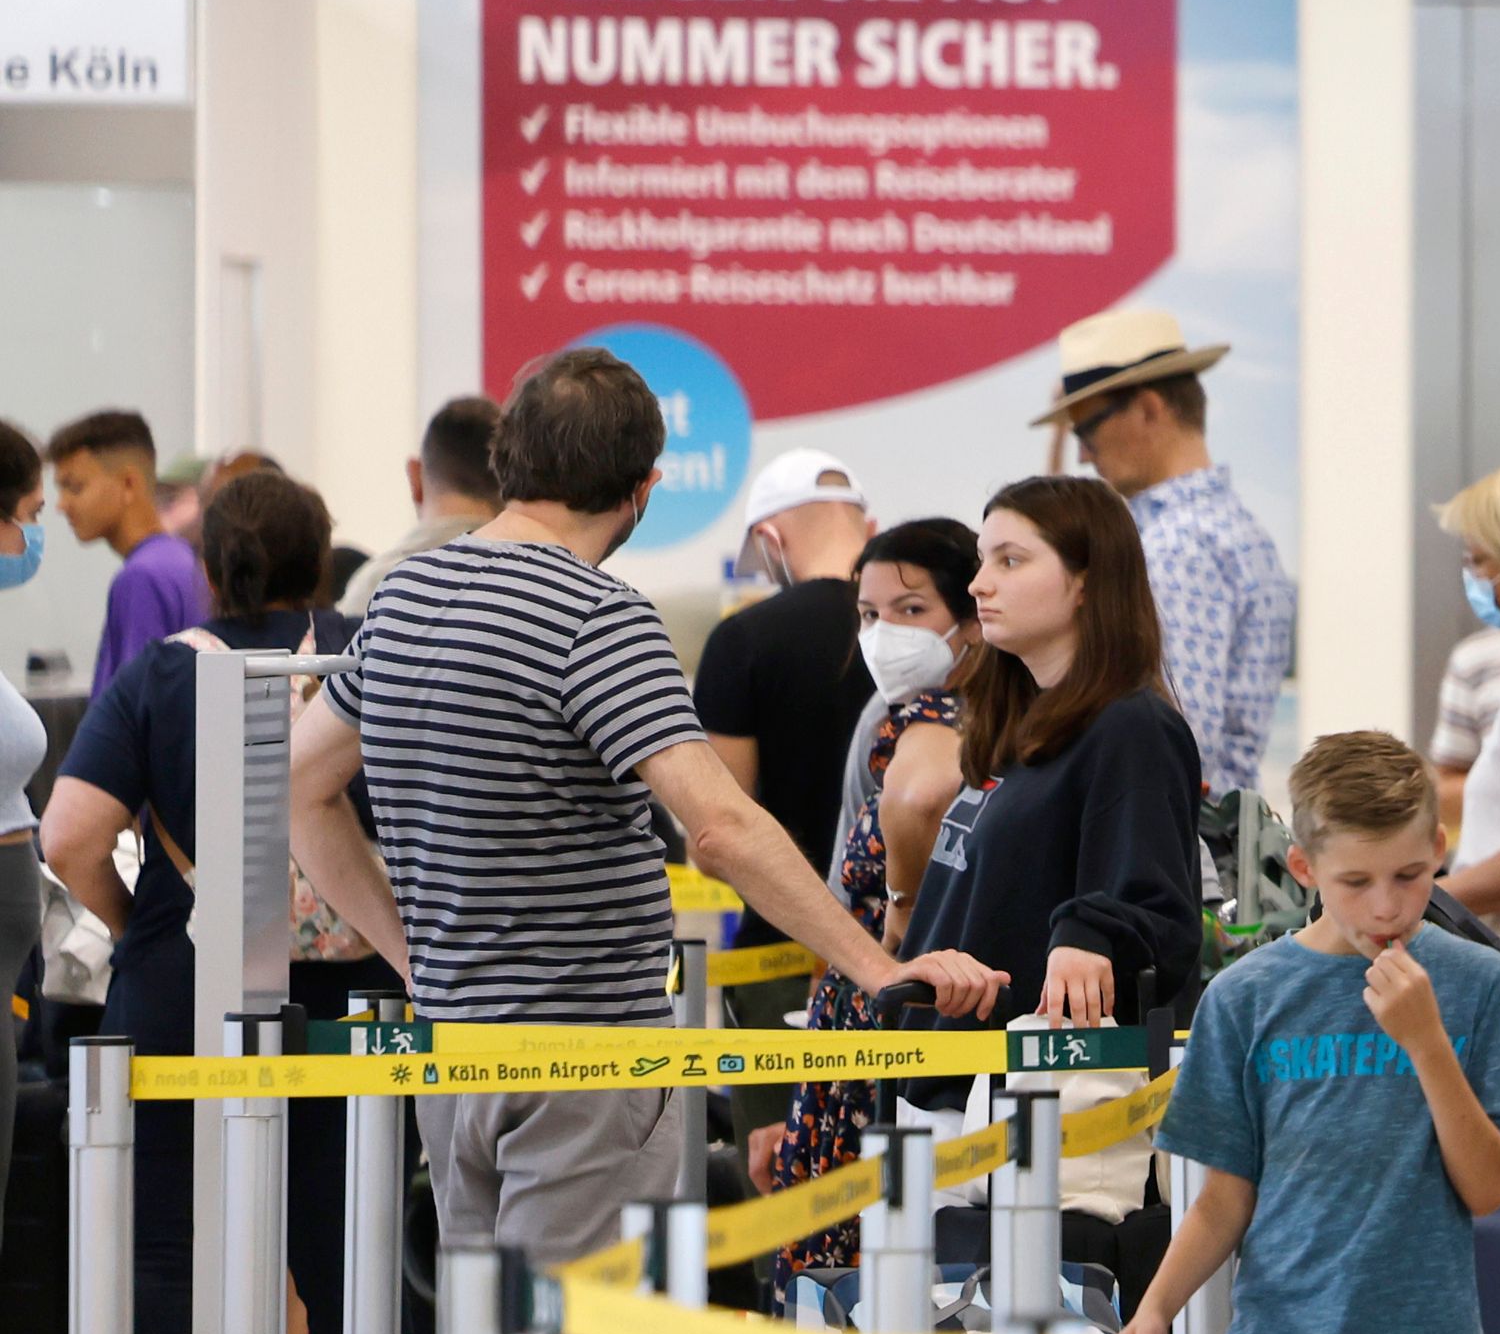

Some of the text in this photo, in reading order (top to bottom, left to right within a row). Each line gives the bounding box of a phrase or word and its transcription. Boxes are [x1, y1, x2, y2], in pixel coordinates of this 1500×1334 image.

[48, 47, 159, 90] Köln
[516, 18, 1119, 90] NUMMER SICHER.
[564, 104, 1049, 156] Flexible Umbuchungsoptionen
[564, 157, 1075, 201] Informiert mit dem Reiseberater
[563, 209, 1113, 259] Rückholgarantie nach Deutschland
[883, 264, 1016, 306] buchbar
[448, 1059, 620, 1083] Köln Bonn Airport
[753, 1046, 926, 1072] Köln Bonn Airport
